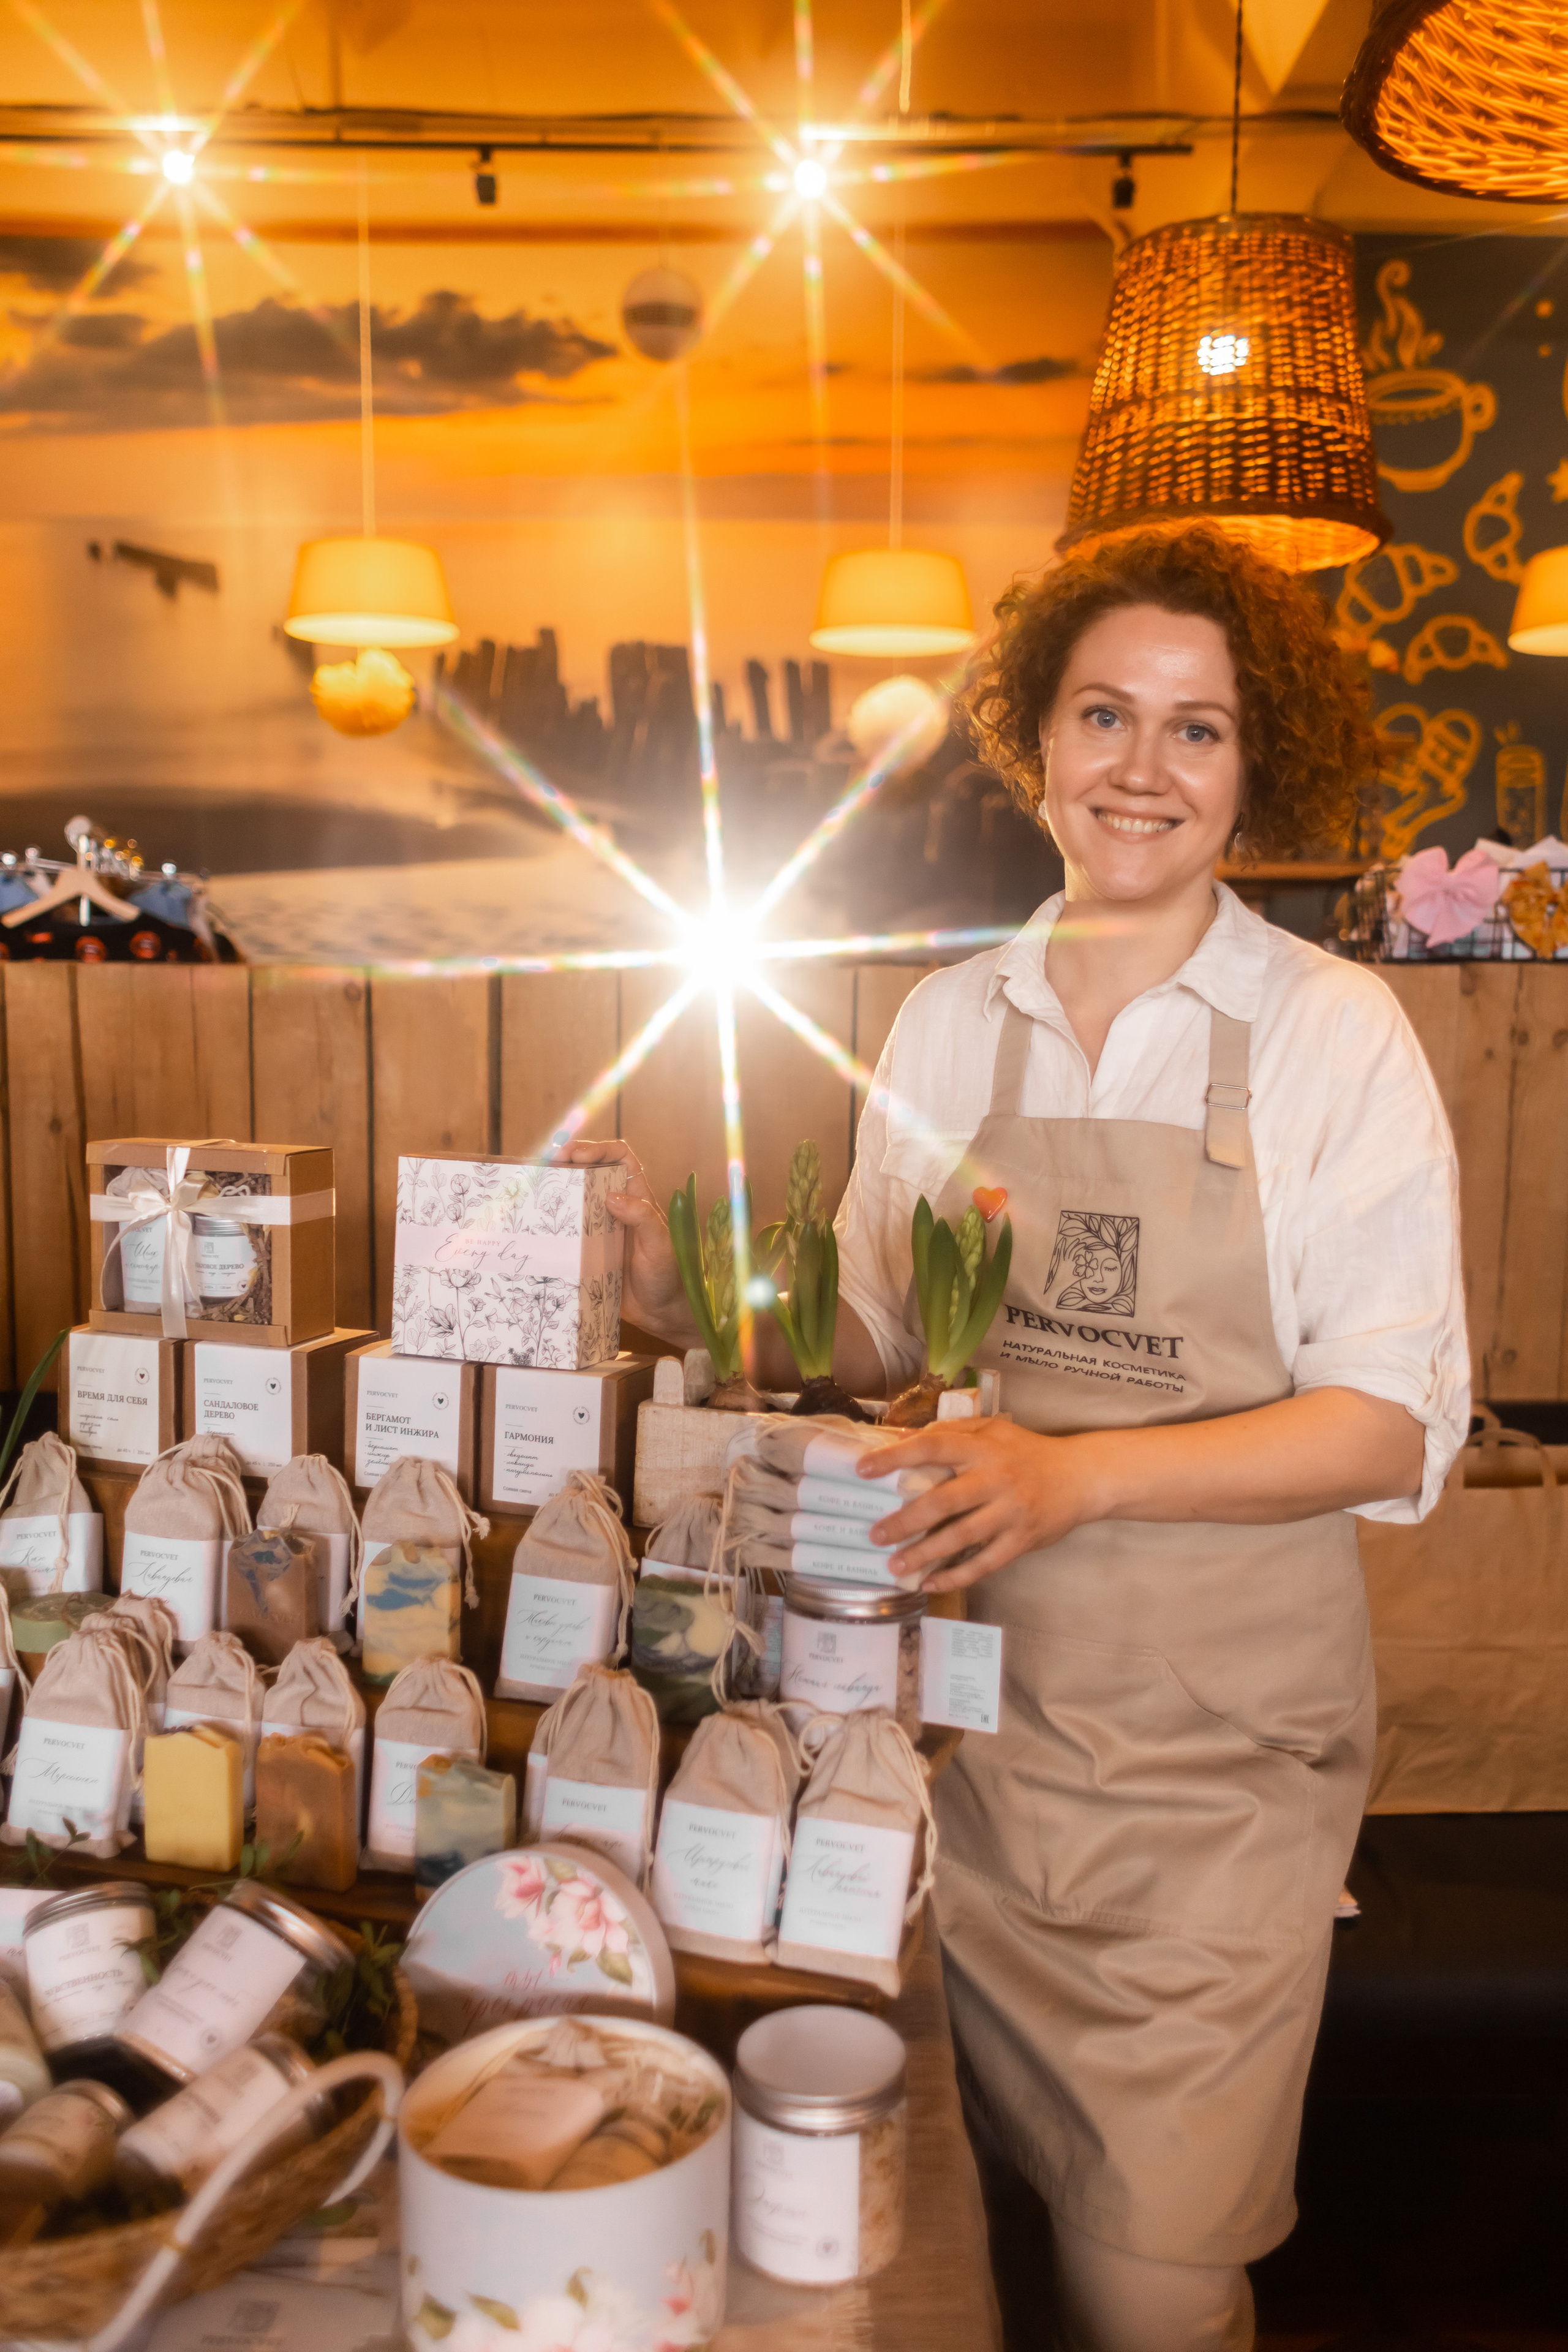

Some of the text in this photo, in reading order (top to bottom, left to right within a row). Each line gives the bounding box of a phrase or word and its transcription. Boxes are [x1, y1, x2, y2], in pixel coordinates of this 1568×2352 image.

[435, 1233, 532, 1273] Every day
[1005, 1304, 1183, 1359] PERVOCVET
[1003, 1340, 1186, 1381] НАТУРАЛЬНАЯ КОСМЕТИКА
[1015, 1355, 1059, 1370] МЫЛО
[1064, 1365, 1121, 1382] РУЧНОЙ
[1126, 1377, 1184, 1393] РАБОТЫ
[77, 1390, 148, 1406] ВРЕМЯ ДЛЯ СЕБЯ
[203, 1400, 258, 1411] САНДАЛОВОЕ
[505, 1404, 538, 1412] PERVOCVET
[204, 1410, 235, 1419] ДЕРЕВО
[366, 1412, 411, 1424] БЕРГАМОТ
[374, 1424, 398, 1434] ЛИСТ
[400, 1427, 439, 1438] ИНЖИРА
[504, 1431, 554, 1444] ГАРМОНИЯ
[818, 1495, 840, 1505] КОФЕ
[813, 1524, 835, 1533] КОФЕ
[16, 1531, 56, 1540] PERVOCVET
[140, 1550, 179, 1561] PERVOCVET
[813, 1561, 834, 1570] КОФЕ
[846, 1565, 878, 1575] ВАНИЛЬ
[533, 1593, 576, 1606] PERVOCVET
[43, 1737, 86, 1750] PERVOCVET
